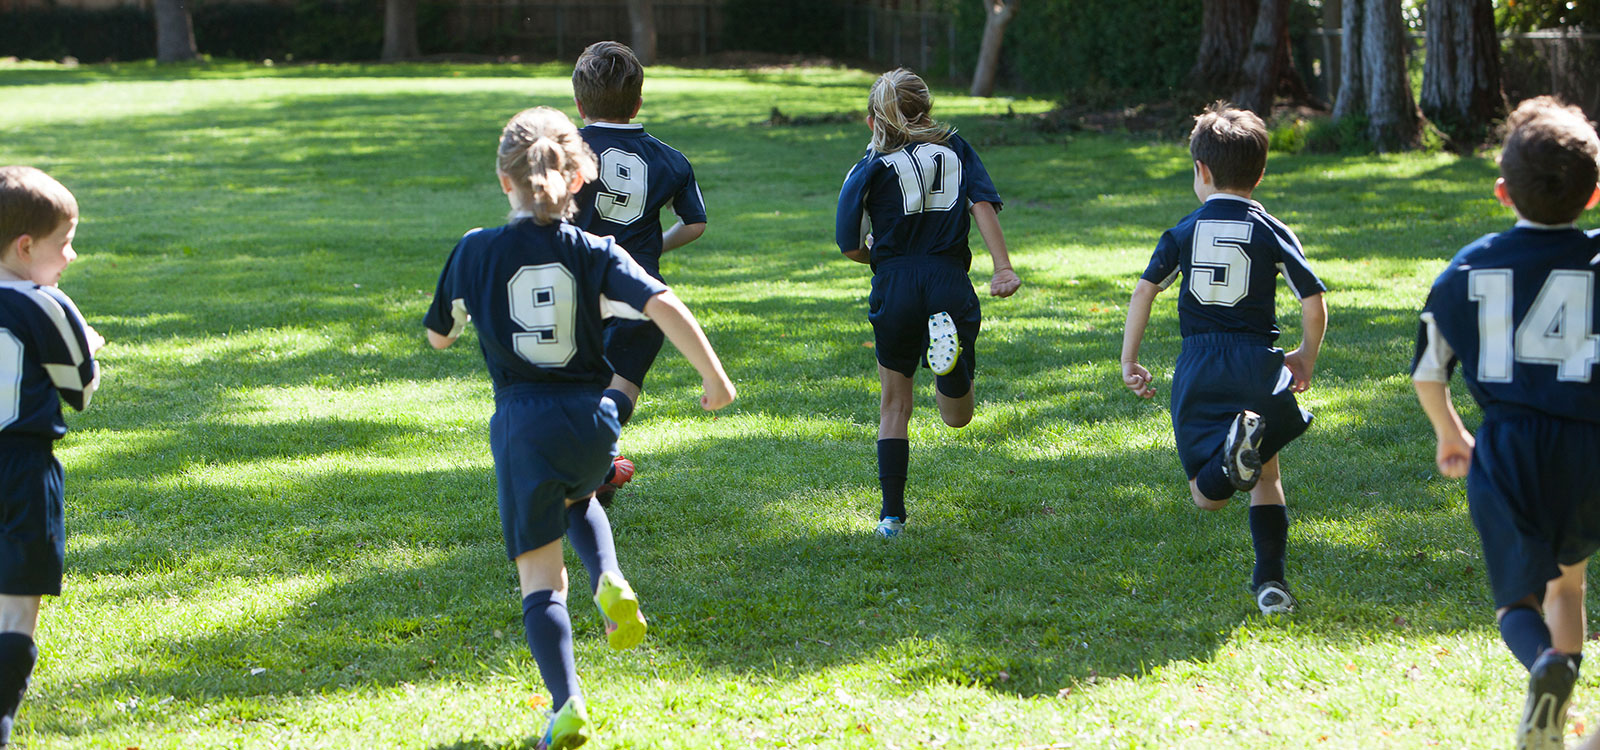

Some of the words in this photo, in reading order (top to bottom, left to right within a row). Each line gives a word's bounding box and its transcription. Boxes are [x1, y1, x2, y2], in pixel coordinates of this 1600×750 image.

[596, 147, 648, 225] 9
[880, 143, 962, 215] 10
[1190, 220, 1254, 307] 5
[508, 263, 577, 367] 9
[1468, 269, 1600, 382] 14
